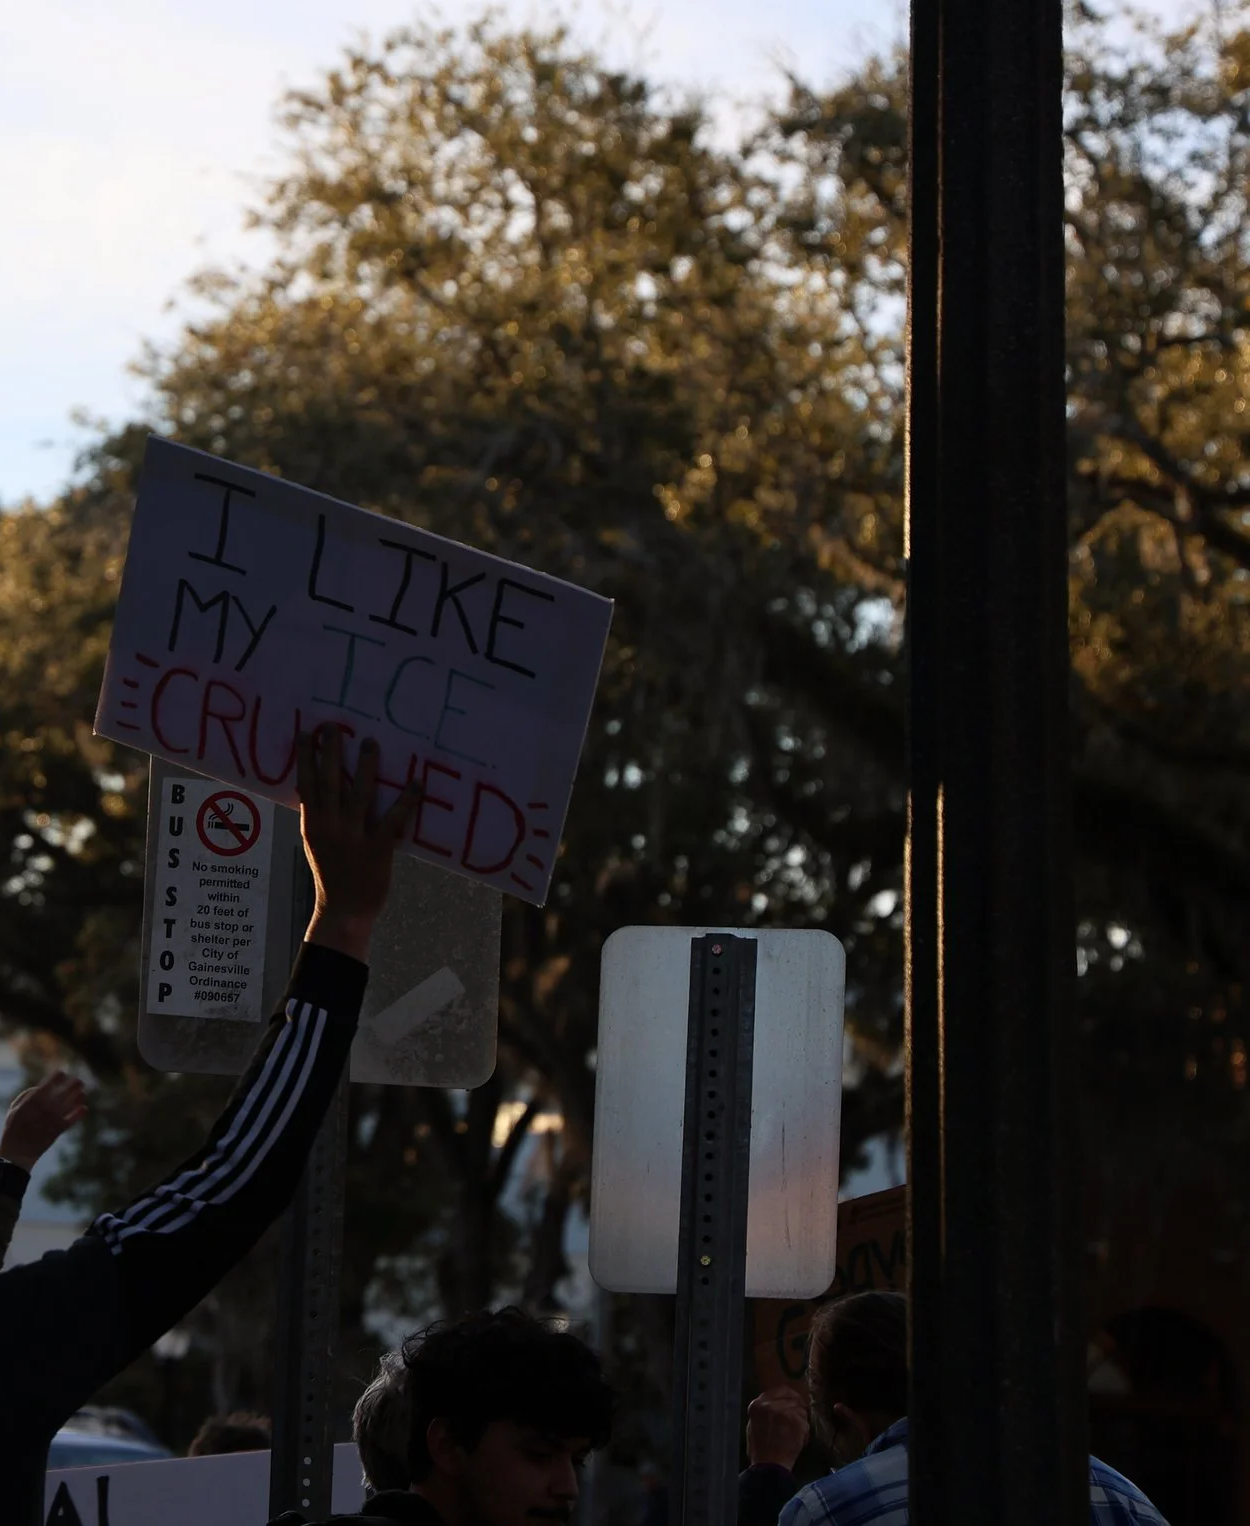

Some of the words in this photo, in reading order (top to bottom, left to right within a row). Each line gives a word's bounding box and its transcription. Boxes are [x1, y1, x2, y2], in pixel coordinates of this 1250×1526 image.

[188, 472, 256, 577] I
[308, 513, 556, 679] LIKE
[168, 578, 278, 673] MY
[312, 623, 497, 770] ICE
[151, 667, 527, 875] CRUED
[167, 783, 186, 869] BUS
[192, 861, 208, 872] No
[210, 864, 259, 878] smoking
[199, 878, 250, 890] permitted
[207, 891, 240, 903] within
[196, 904, 211, 915] 20
[213, 905, 235, 917] feet
[237, 907, 250, 918] of
[190, 918, 211, 930] bus
[213, 921, 239, 933] stop
[241, 924, 255, 932] or
[157, 886, 177, 1004] STOP
[190, 933, 231, 945] shelter
[232, 938, 252, 948] per
[202, 947, 225, 961] City
[227, 950, 239, 960] of
[188, 961, 250, 976] Gainesville
[189, 975, 247, 990] Ordinance
